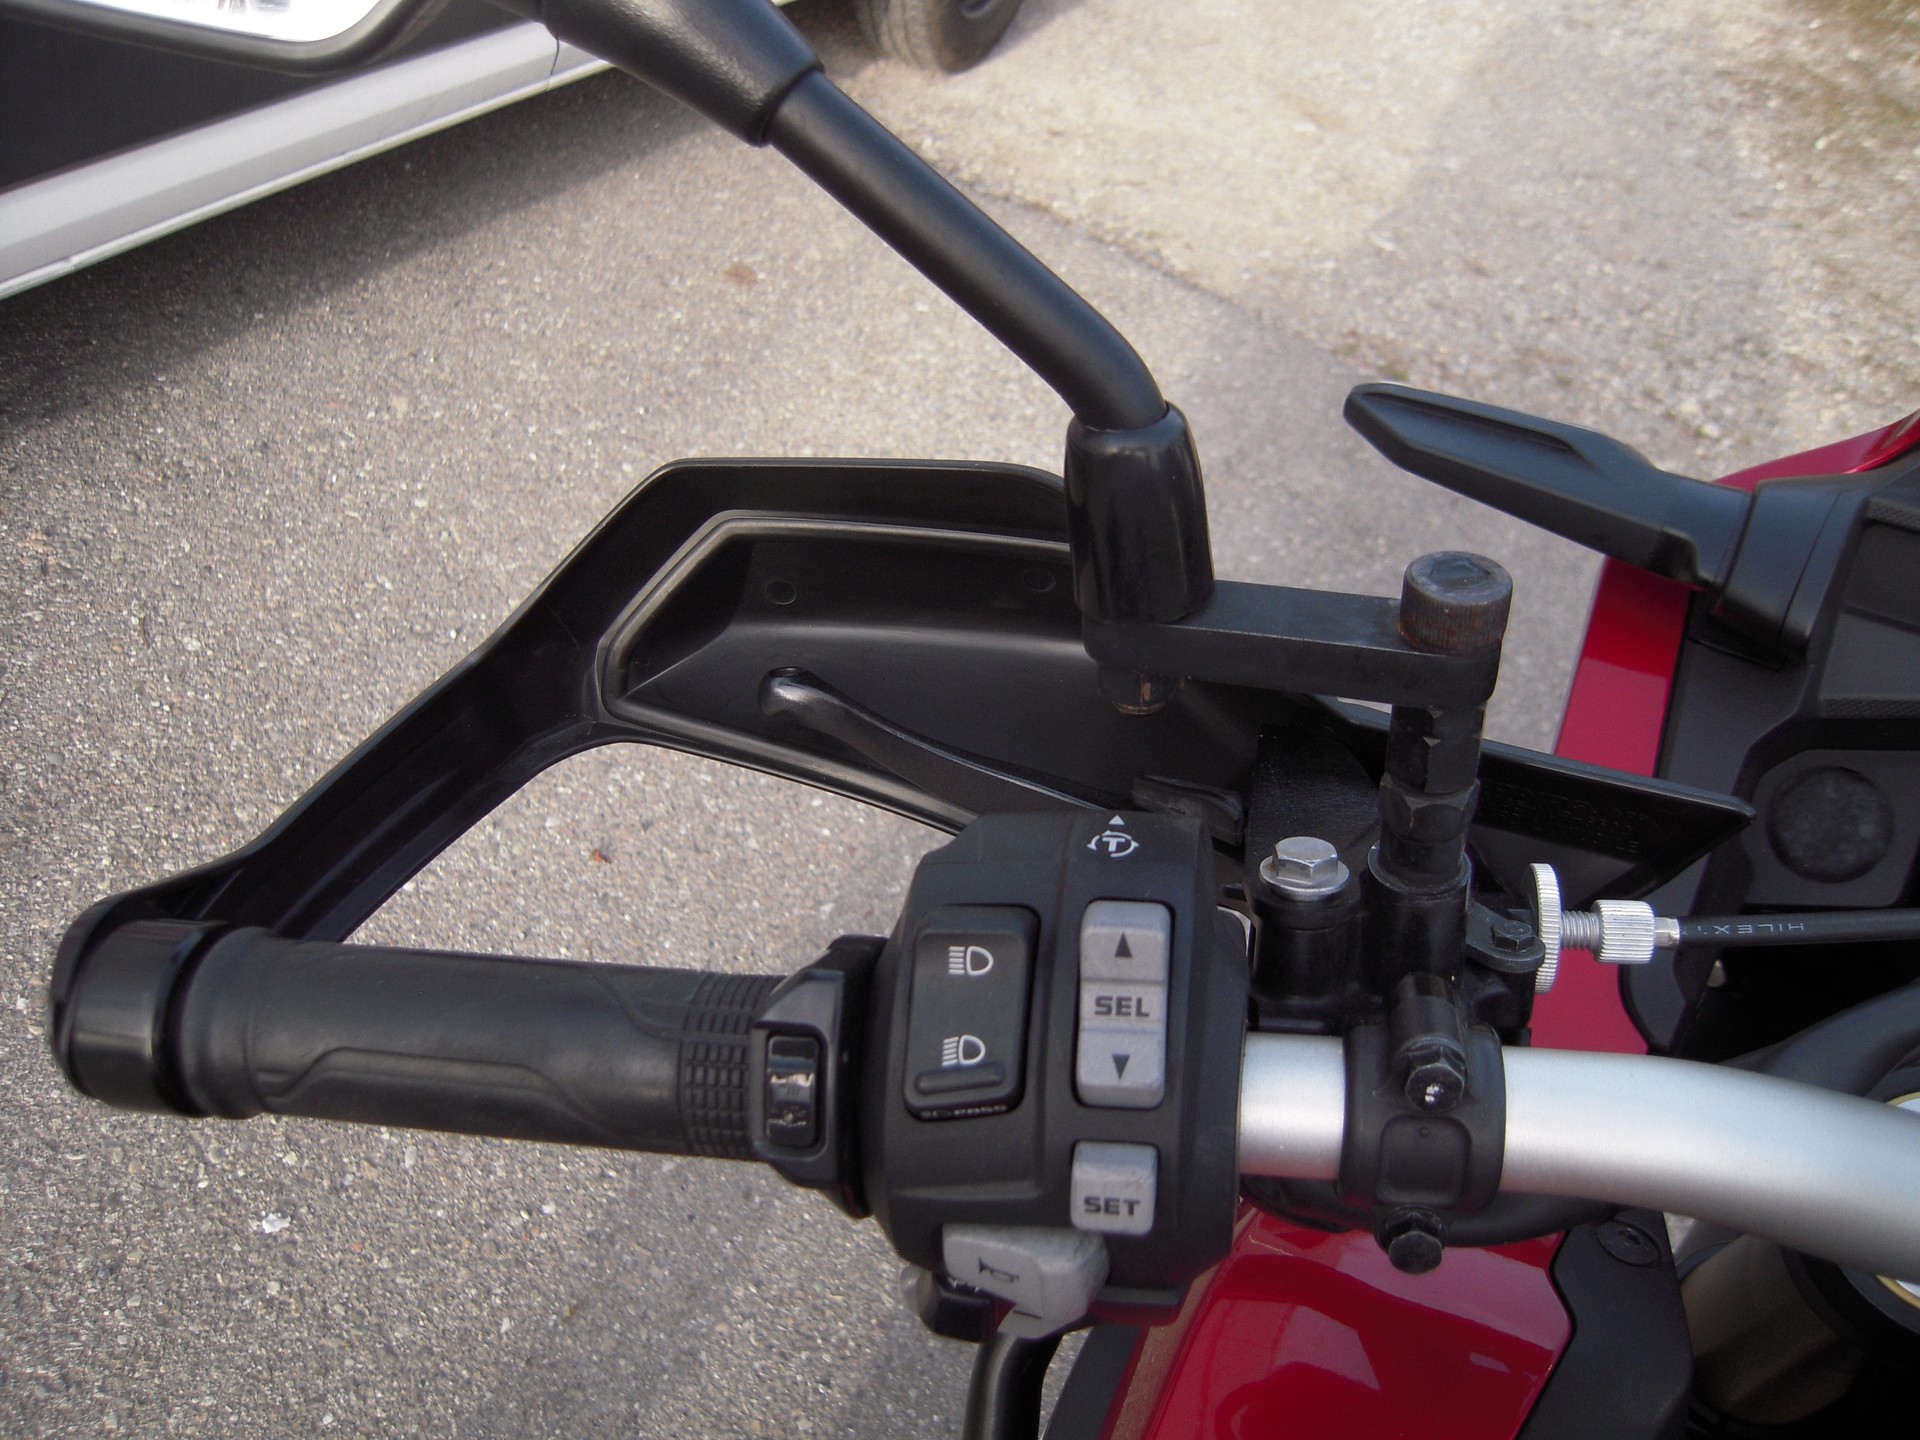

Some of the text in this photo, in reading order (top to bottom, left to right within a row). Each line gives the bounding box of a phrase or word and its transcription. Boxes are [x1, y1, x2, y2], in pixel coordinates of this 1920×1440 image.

[1713, 923, 1804, 934] HILEX
[1094, 996, 1150, 1017] SEL
[1084, 1196, 1141, 1217] SET
